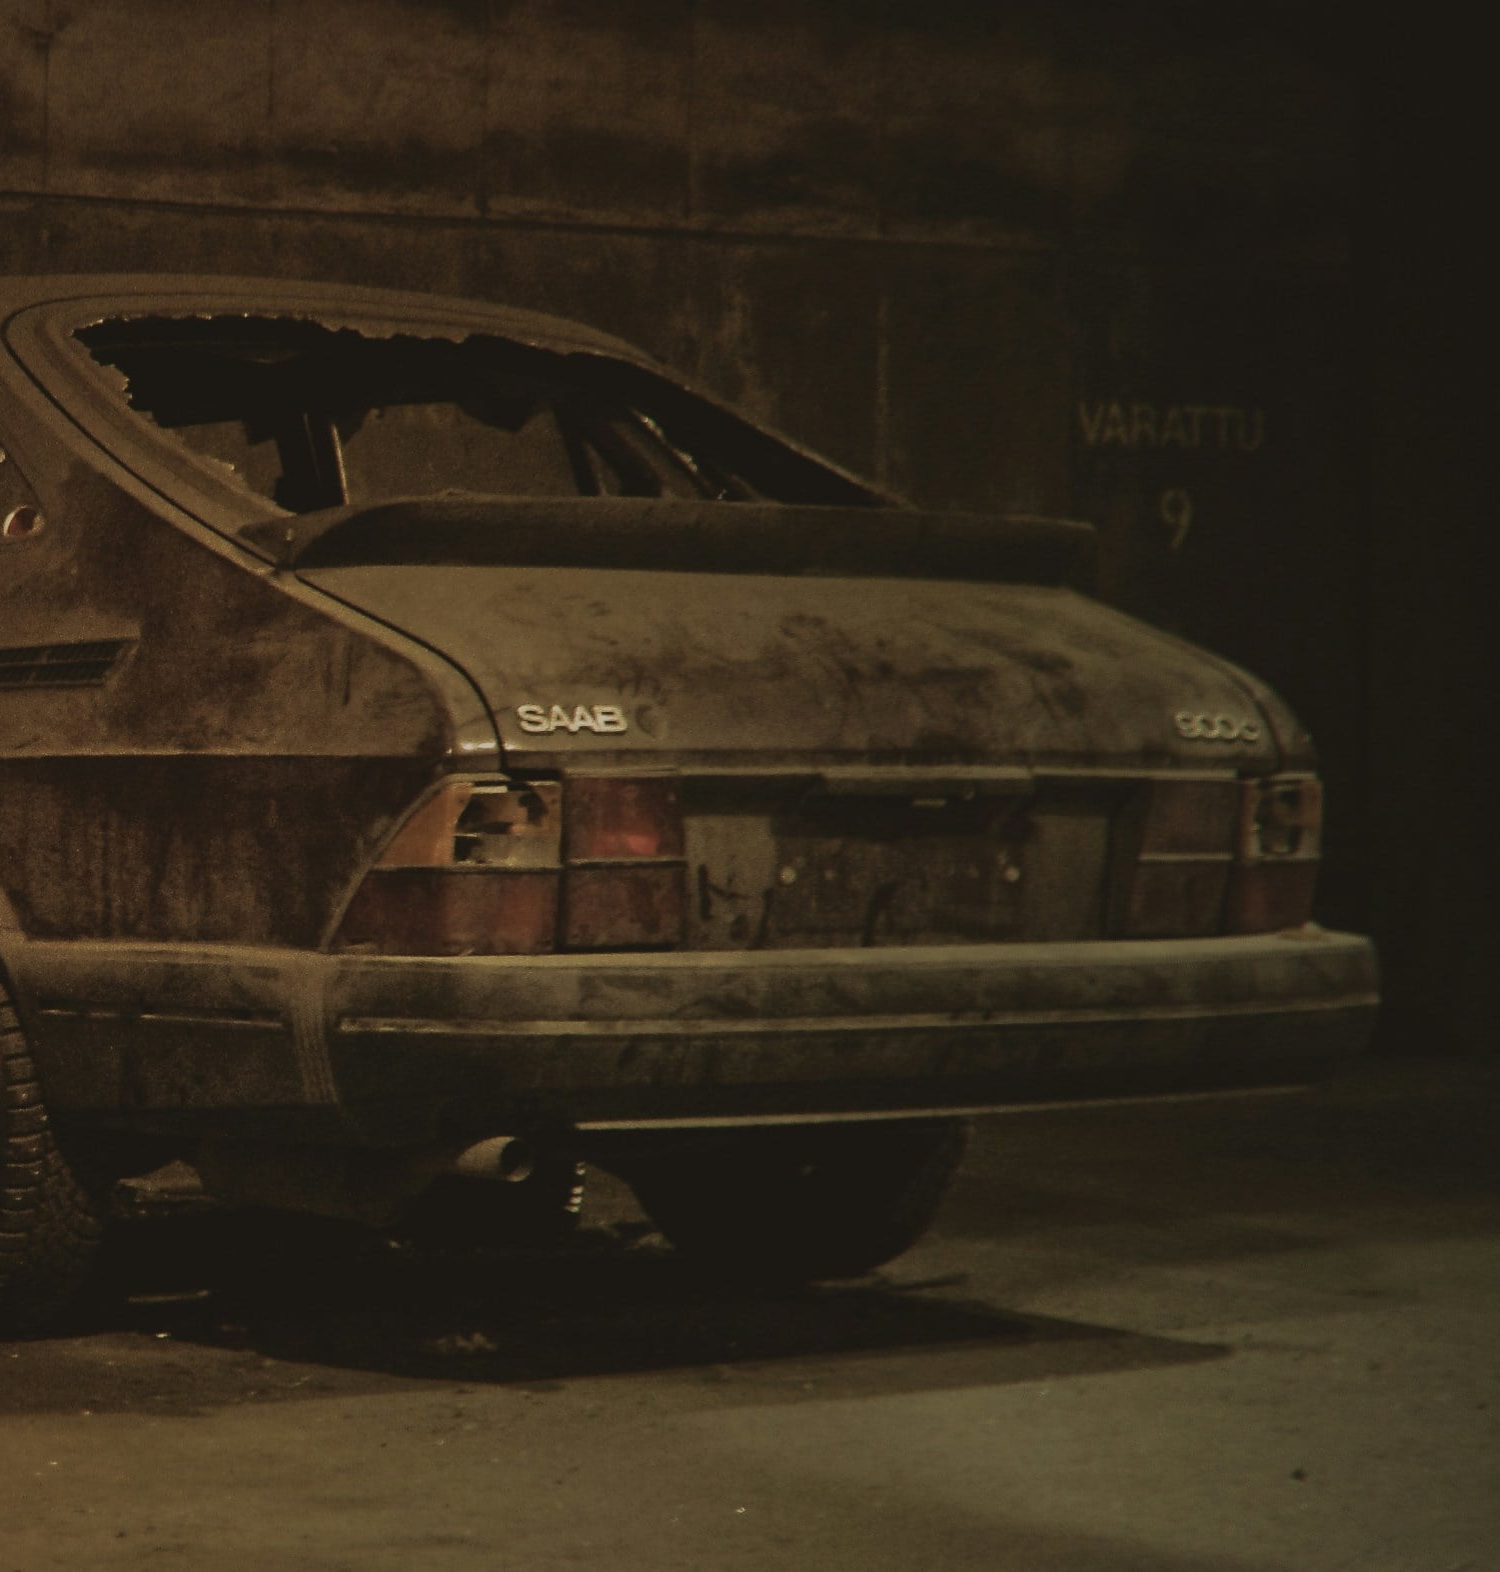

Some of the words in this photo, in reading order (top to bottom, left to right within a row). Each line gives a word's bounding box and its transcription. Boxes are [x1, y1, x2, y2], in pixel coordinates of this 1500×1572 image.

[1078, 399, 1267, 452] VARATTU
[1159, 488, 1193, 550] 9
[517, 703, 628, 734] SAAB
